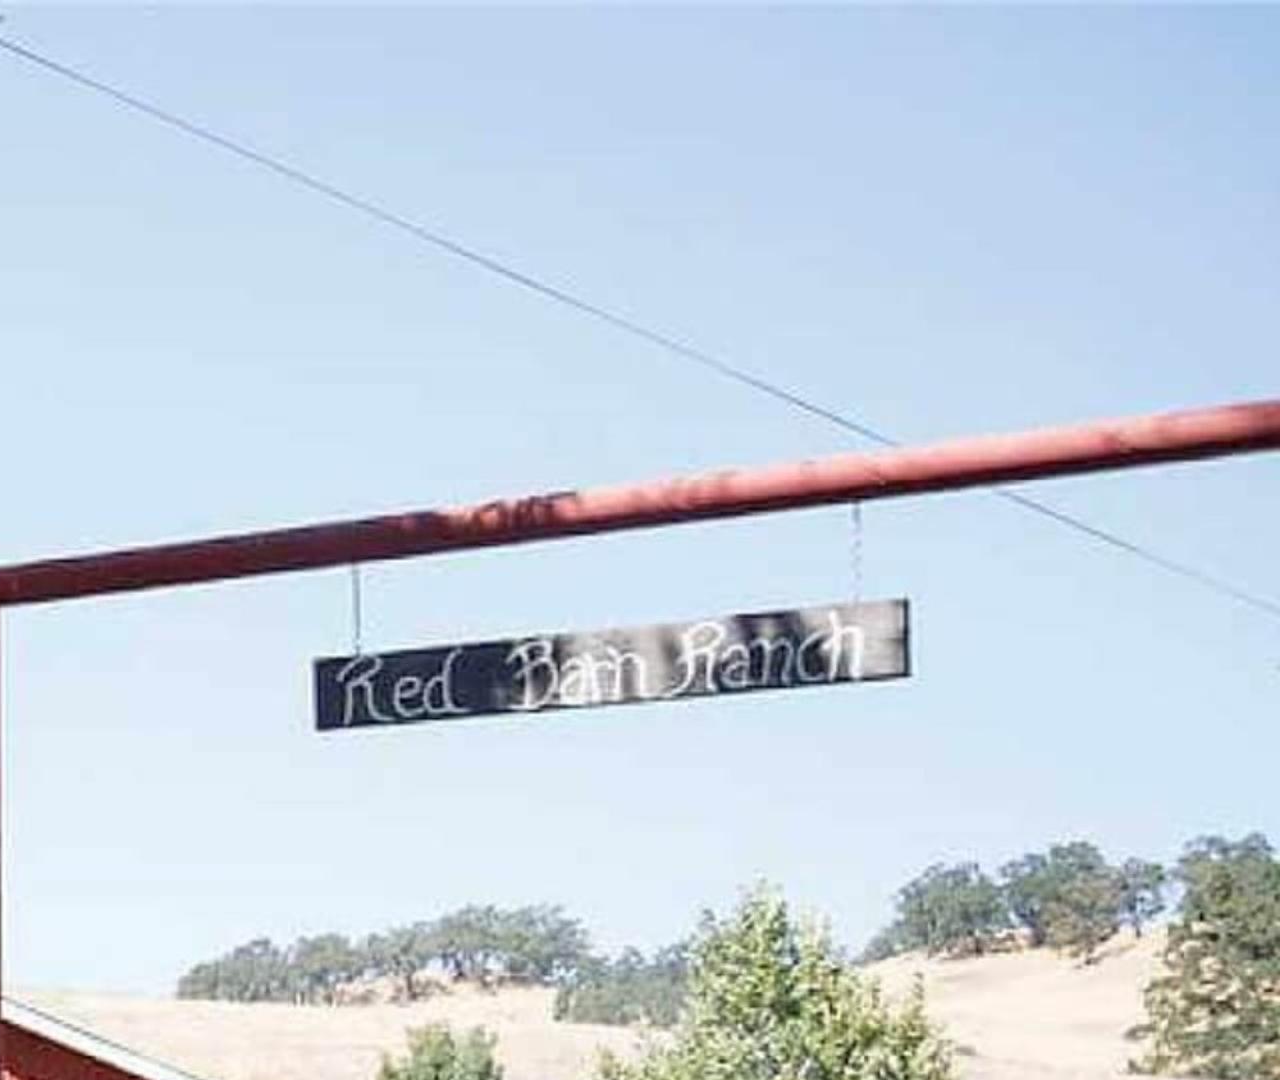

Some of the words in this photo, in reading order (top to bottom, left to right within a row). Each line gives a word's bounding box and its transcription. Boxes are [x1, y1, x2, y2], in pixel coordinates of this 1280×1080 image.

[336, 647, 473, 726] Red
[504, 640, 647, 711] Barn
[670, 608, 865, 697] Ranch
